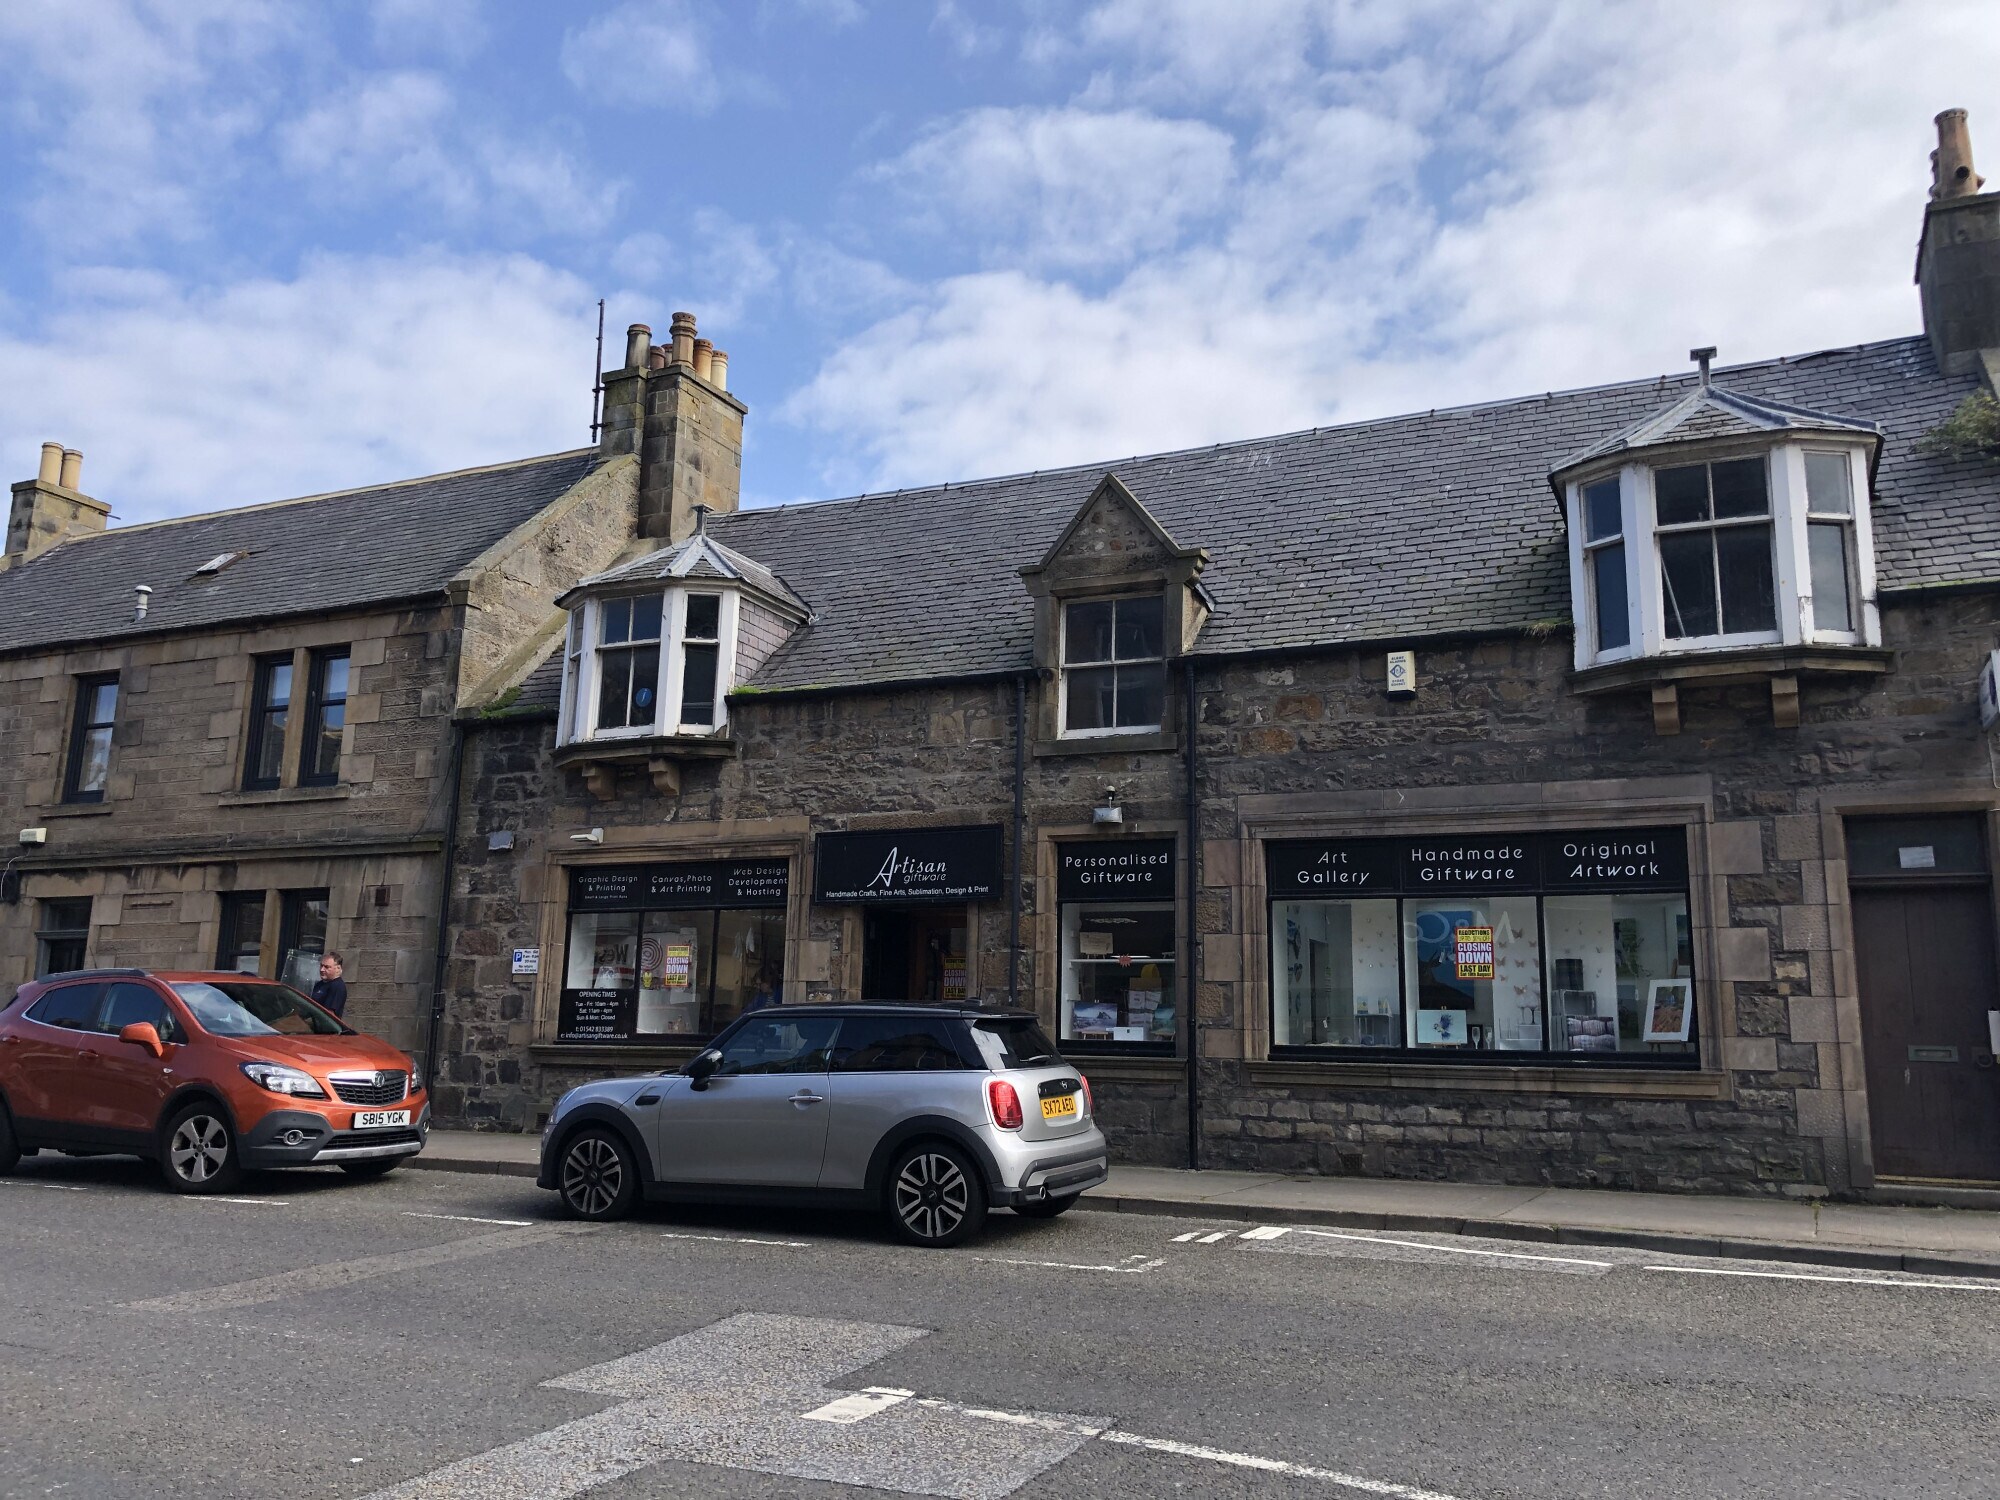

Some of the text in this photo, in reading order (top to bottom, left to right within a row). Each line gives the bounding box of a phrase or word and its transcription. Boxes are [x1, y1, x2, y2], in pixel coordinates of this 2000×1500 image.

[1411, 846, 1523, 862] Handmade
[1563, 840, 1655, 860] Original
[1065, 852, 1168, 868] Personalised
[1317, 851, 1348, 864] Art
[756, 868, 787, 876] Design
[866, 846, 947, 888] Artisan
[1570, 861, 1659, 878] Artwork
[903, 872, 947, 884] giftware
[1080, 871, 1152, 884] Giftware
[1297, 870, 1370, 885] Gallery
[1420, 867, 1515, 881] Giftware
[728, 878, 788, 886] Development
[676, 885, 712, 893] Printing
[746, 888, 781, 897] Hosting
[908, 888, 944, 896] Sublimation,
[945, 887, 966, 895] Design
[1458, 942, 1492, 952] CLOSING
[666, 956, 688, 964] CLOSING
[1458, 952, 1492, 964] DOWN
[666, 964, 688, 974] DOWN
[1460, 964, 1477, 972] LAST
[566, 1032, 628, 1040] info@artisangiftware.co.uk
[1043, 1100, 1062, 1115] SX72
[362, 1112, 405, 1125] SB15 YGK
